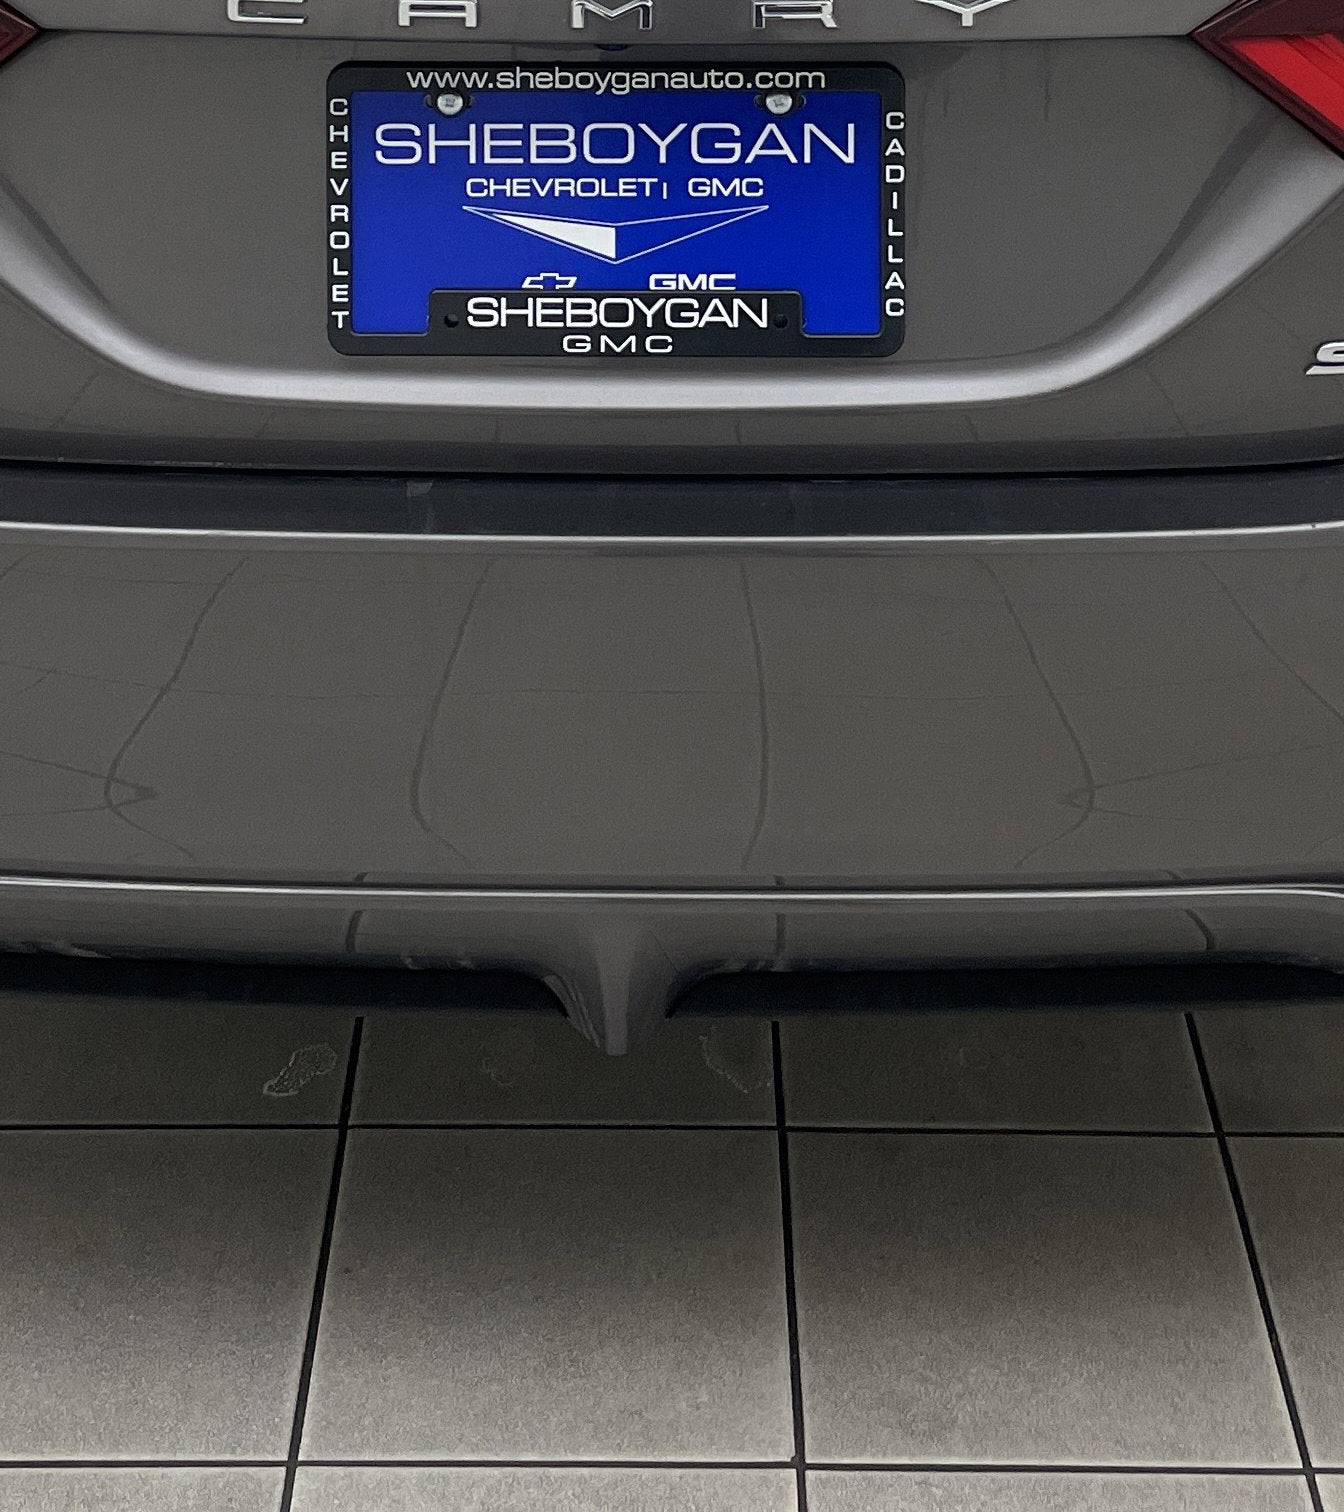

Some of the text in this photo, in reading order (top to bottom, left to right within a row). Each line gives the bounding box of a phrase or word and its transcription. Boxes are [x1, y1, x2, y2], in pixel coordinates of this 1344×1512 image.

[406, 67, 826, 95] www.sheboyganauto.com
[375, 122, 855, 165] SHEBOYGAN
[466, 177, 764, 197] CHEVROLET GMC
[329, 98, 350, 329] CHEVROLET
[884, 111, 904, 317] CADILLAC
[649, 273, 737, 291] GMC
[466, 297, 768, 329] SHEBOYGAN
[562, 334, 673, 354] GMC
